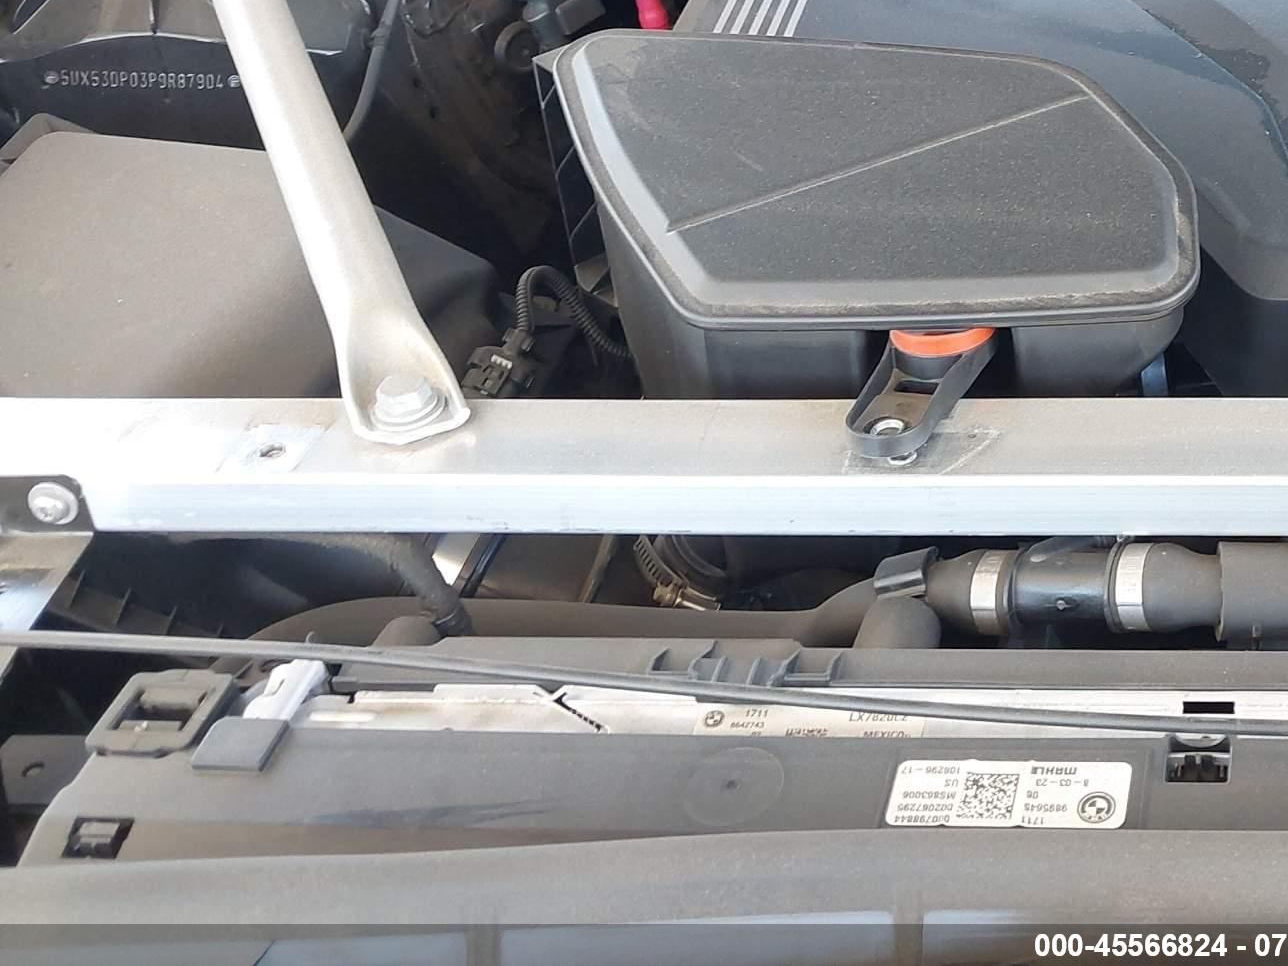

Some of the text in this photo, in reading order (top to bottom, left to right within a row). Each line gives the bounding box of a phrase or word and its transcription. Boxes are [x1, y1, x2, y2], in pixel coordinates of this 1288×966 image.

[60, 69, 225, 91] 5UX53DP03P9R87904
[1030, 765, 1078, 776] MAHLE
[943, 778, 960, 788] US
